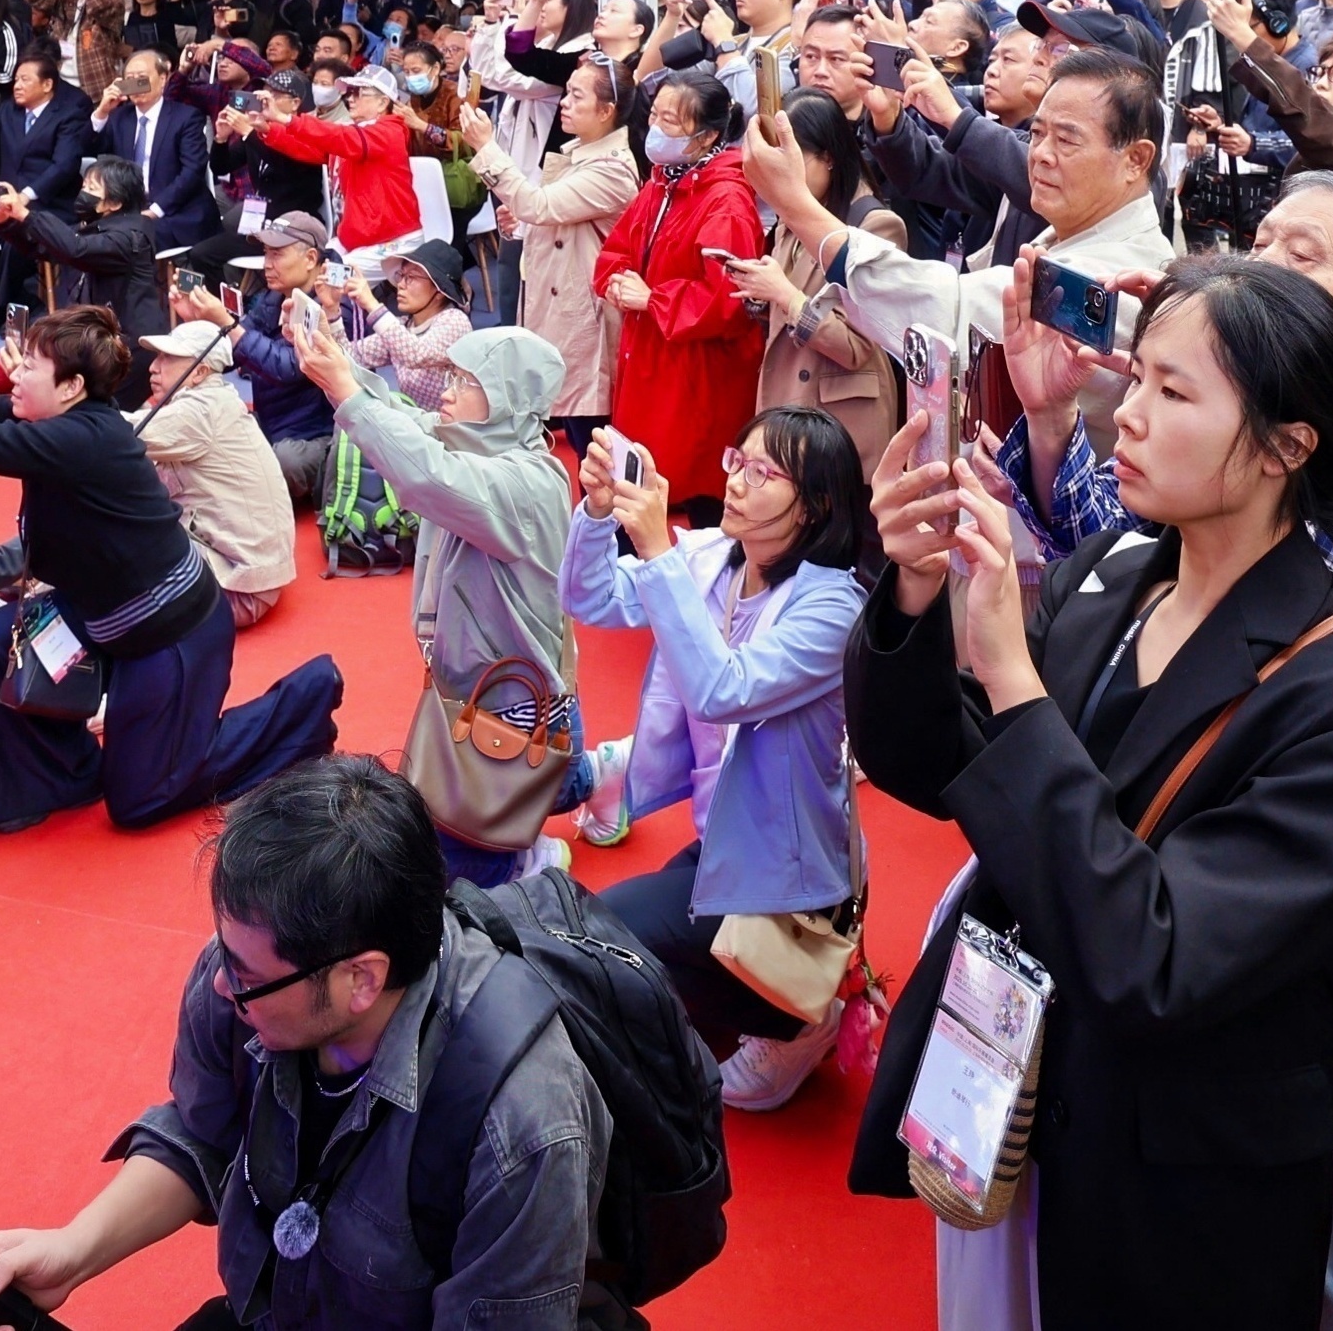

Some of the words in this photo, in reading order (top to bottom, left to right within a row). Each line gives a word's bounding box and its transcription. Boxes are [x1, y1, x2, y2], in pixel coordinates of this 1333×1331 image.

[1124, 619, 1142, 641] music
[1109, 643, 1126, 666] CHINA
[937, 1150, 958, 1172] Visitor
